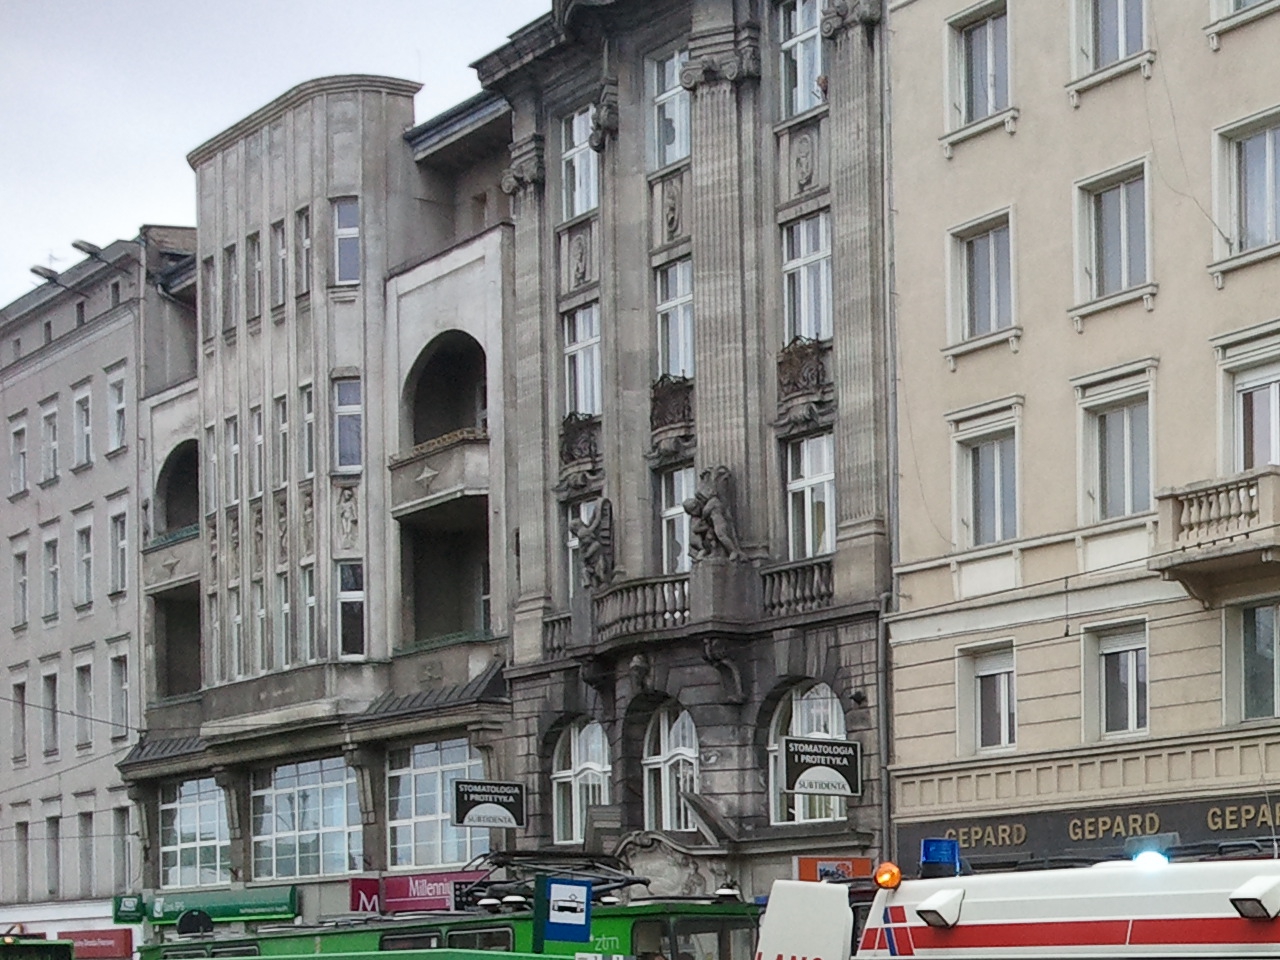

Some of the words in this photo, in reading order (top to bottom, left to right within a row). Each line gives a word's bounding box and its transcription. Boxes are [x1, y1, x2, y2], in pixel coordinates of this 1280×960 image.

[789, 743, 854, 755] STOMATOLOGIA
[794, 754, 798, 763] I
[801, 754, 849, 766] PROTETYKA
[459, 784, 520, 794] STOMATOLOGIA
[470, 794, 515, 803] PROTETYKA
[1069, 812, 1160, 841] GEPARD
